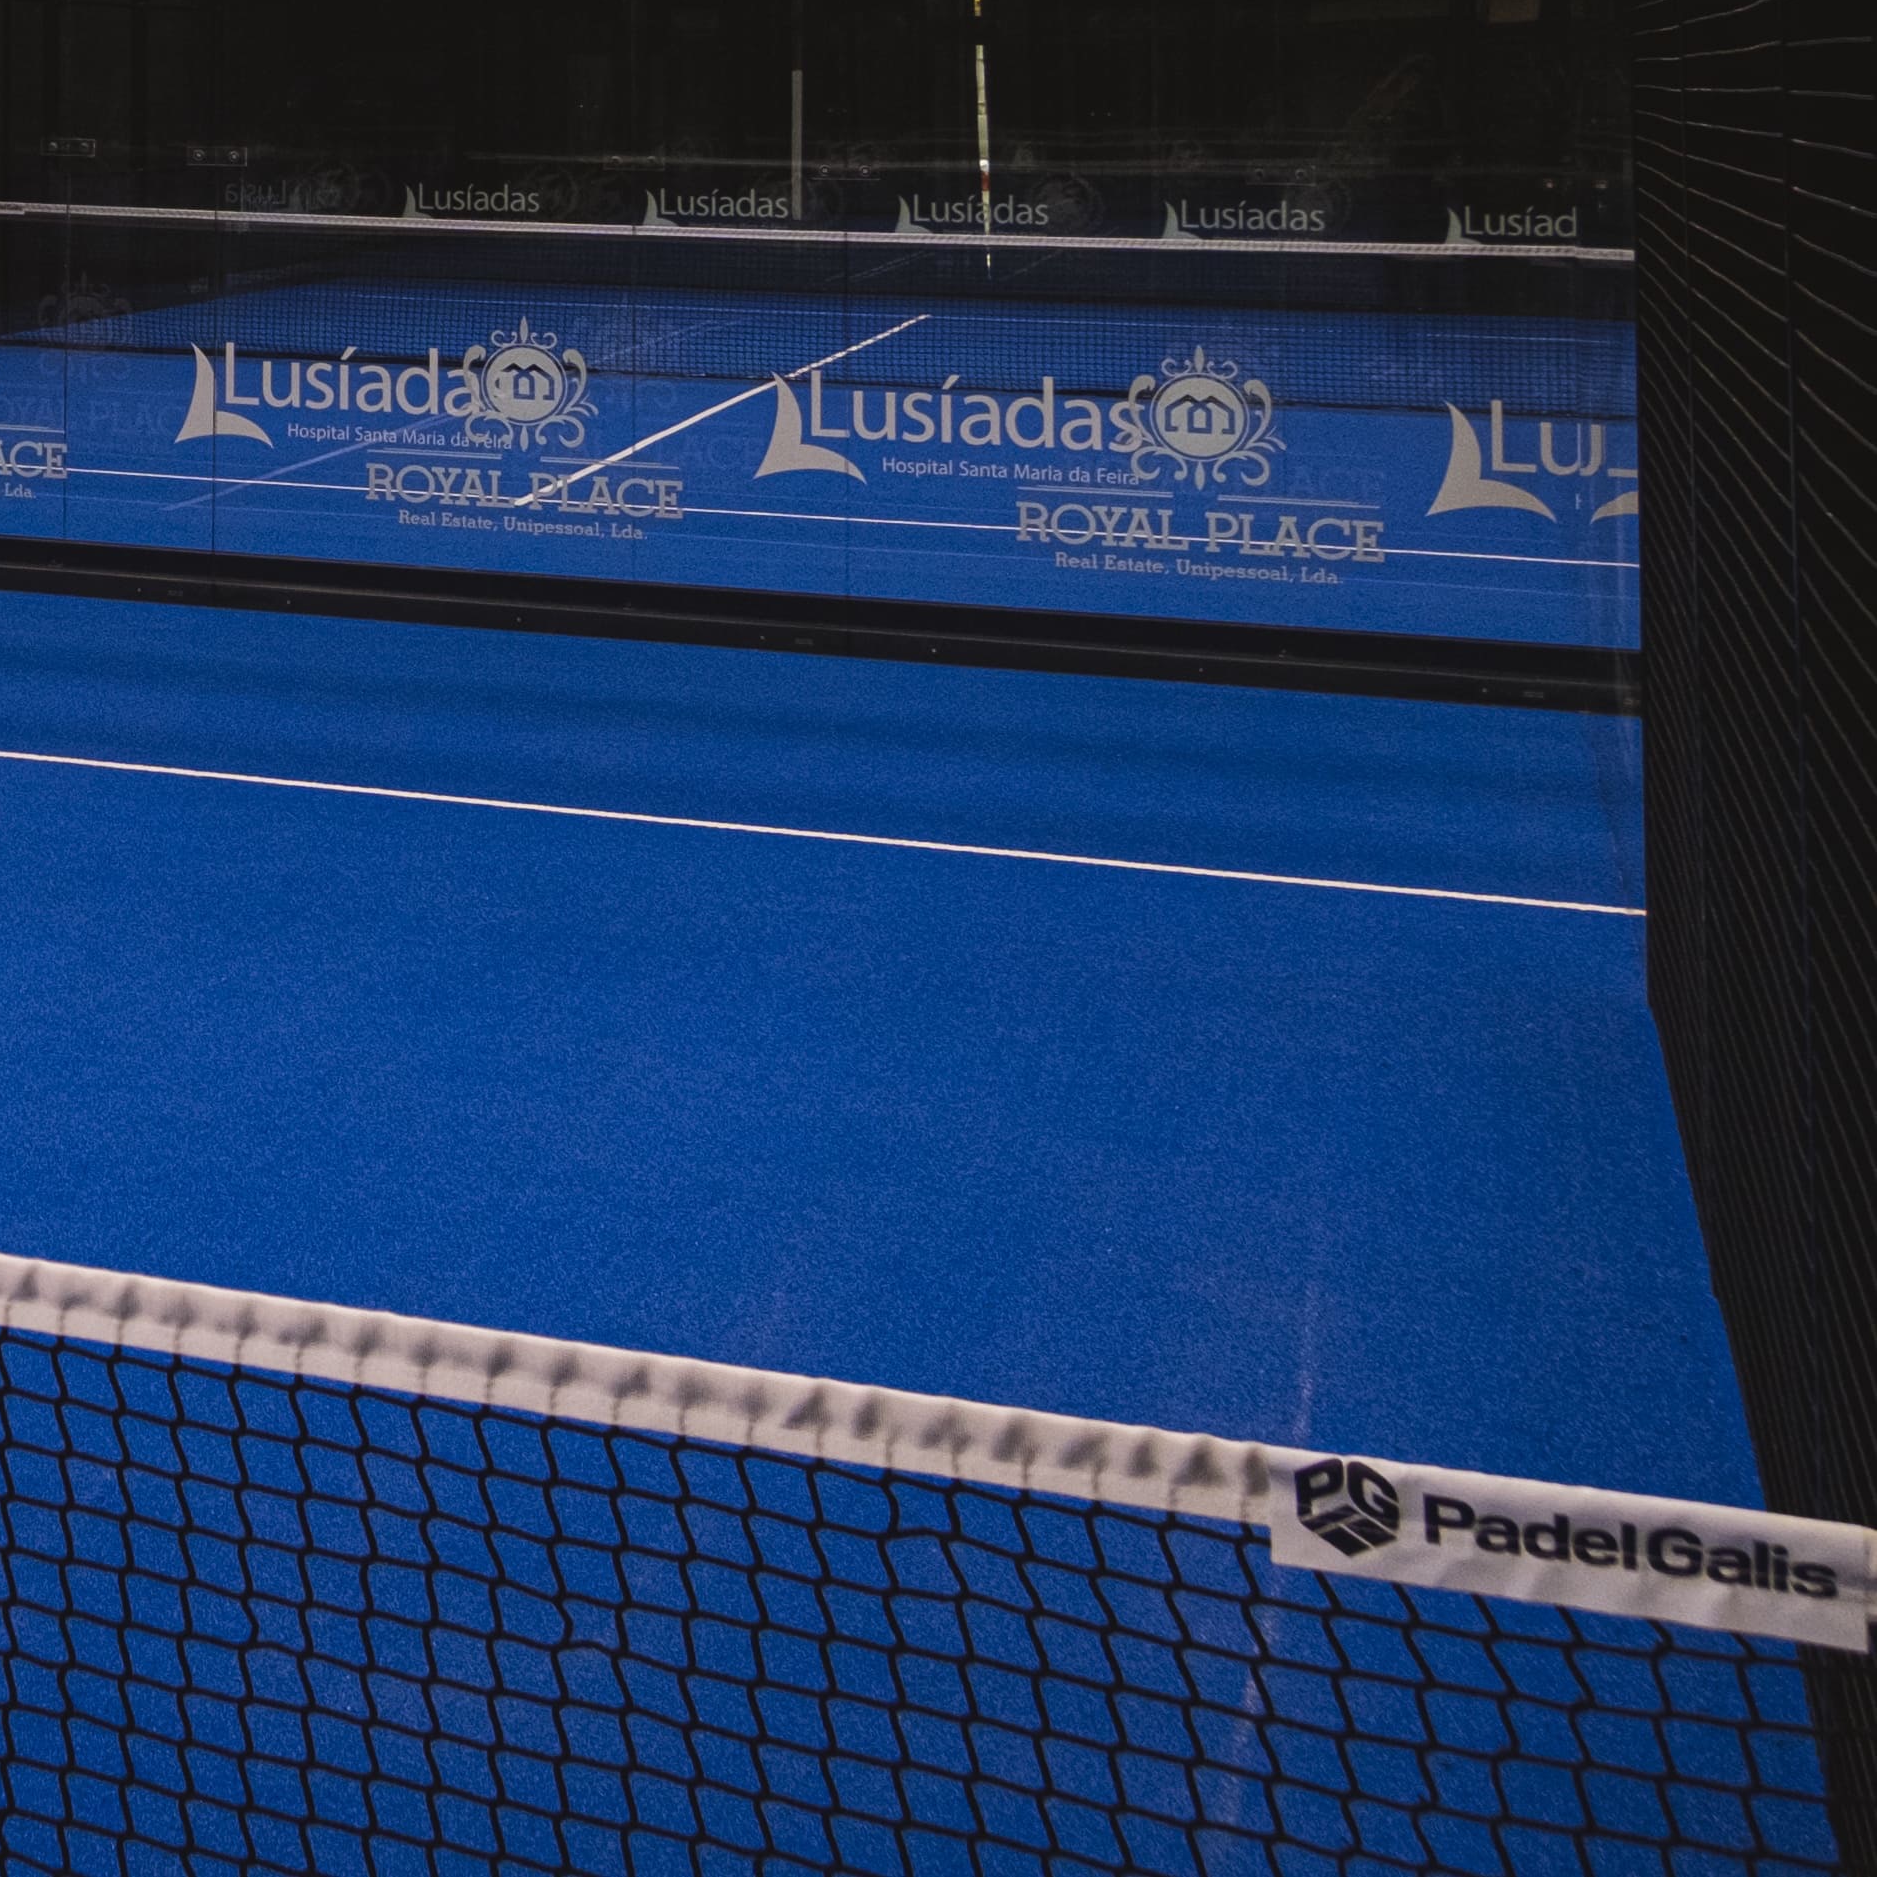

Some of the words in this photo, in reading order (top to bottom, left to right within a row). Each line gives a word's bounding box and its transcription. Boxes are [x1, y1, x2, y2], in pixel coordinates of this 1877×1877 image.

[418, 181, 541, 213] Lusíadas
[659, 187, 789, 220] Lusíadas
[912, 193, 1049, 226] Lusíadas
[1180, 199, 1326, 233] Lusíadas
[223, 341, 499, 418] Lusíada
[809, 369, 1146, 453] Lusíadas
[286, 423, 350, 442] Hospital
[354, 426, 397, 444] Santa
[402, 429, 446, 446] Maria
[882, 457, 953, 478] Hospital
[958, 460, 1008, 479] Santa
[1013, 464, 1064, 483] Maria
[1068, 466, 1091, 484] da
[1096, 467, 1141, 486] Feira
[365, 462, 514, 510] ROYAL
[528, 471, 684, 521] PLACE
[398, 508, 438, 529] Real
[1015, 499, 1191, 553] ROYAL
[1204, 510, 1386, 565] PLACE
[1054, 550, 1100, 572] Real
[1421, 1491, 1839, 1600] PadelGalis
